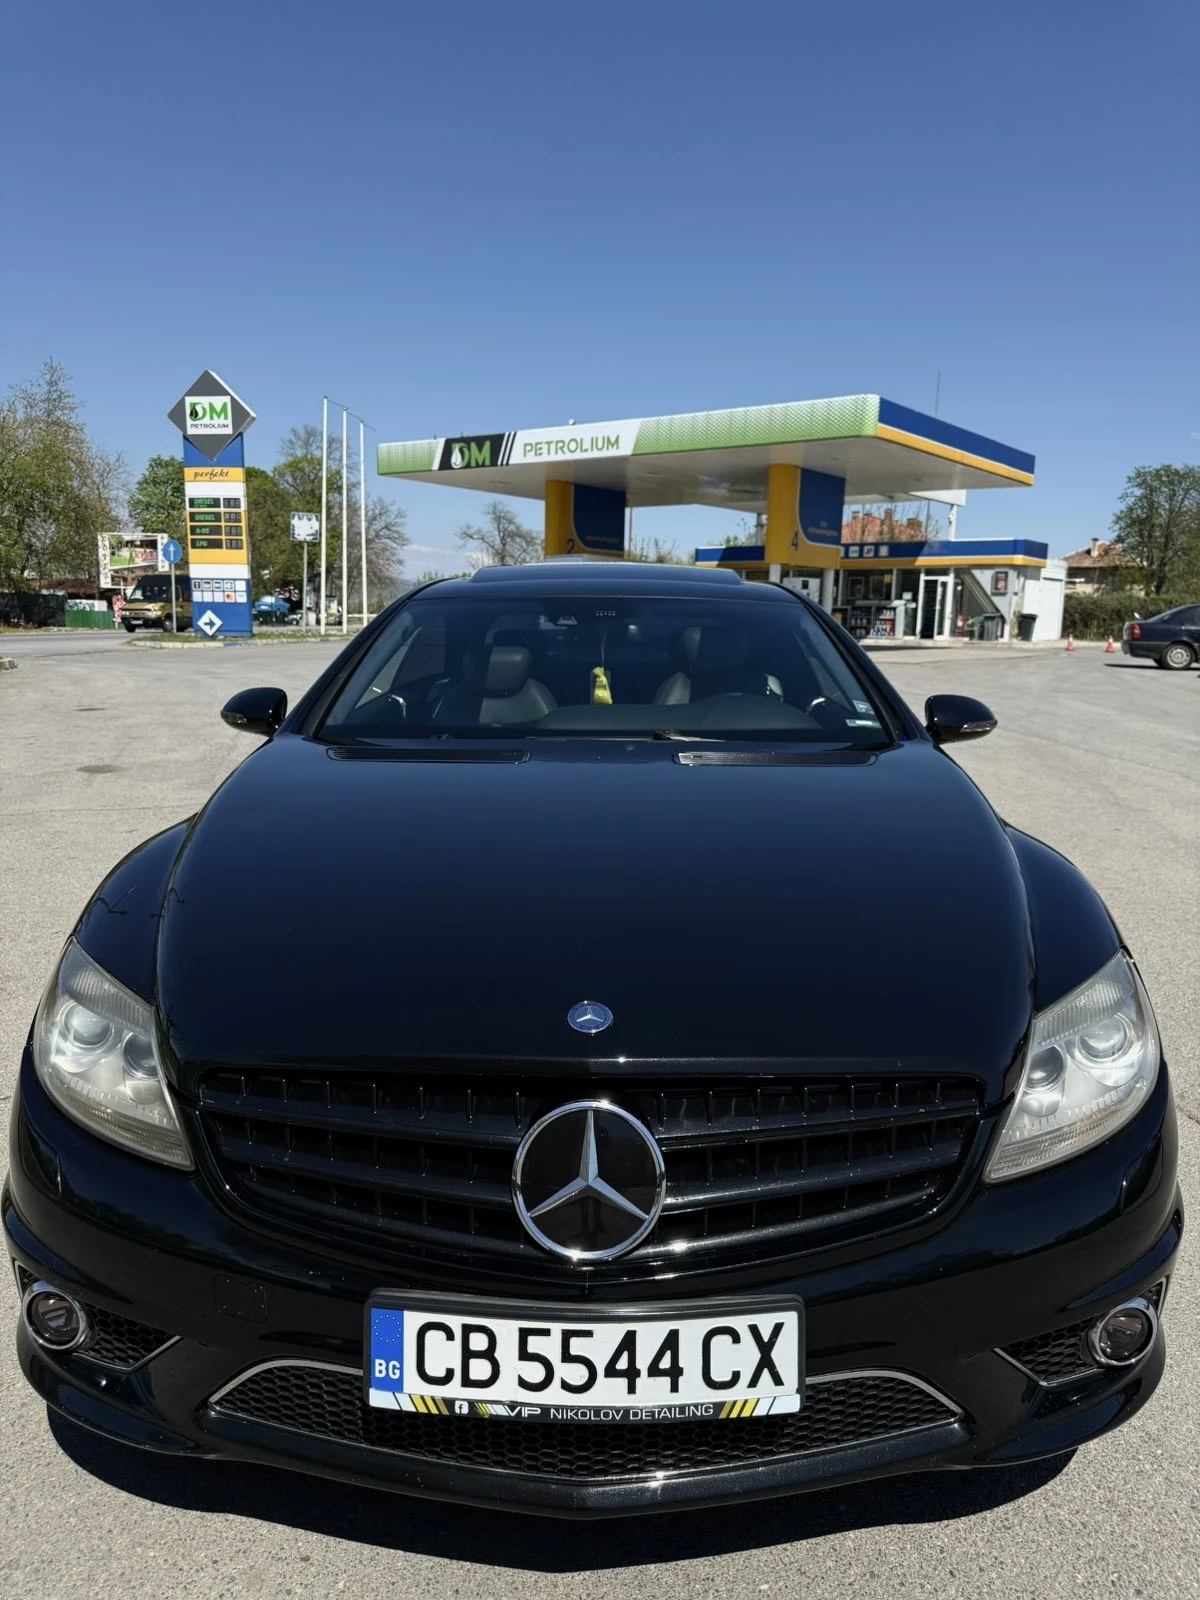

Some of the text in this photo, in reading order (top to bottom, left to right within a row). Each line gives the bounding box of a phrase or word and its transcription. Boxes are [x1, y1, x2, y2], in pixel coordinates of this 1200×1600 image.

[189, 402, 228, 421] DM
[450, 434, 621, 469] DM PETROLIUM
[566, 538, 575, 554] 2
[791, 530, 799, 552] 4
[415, 1320, 785, 1395] CB 5544 CX
[374, 1358, 401, 1380] BG
[508, 1404, 714, 1421] VIP NIKOLOV DETAILING
